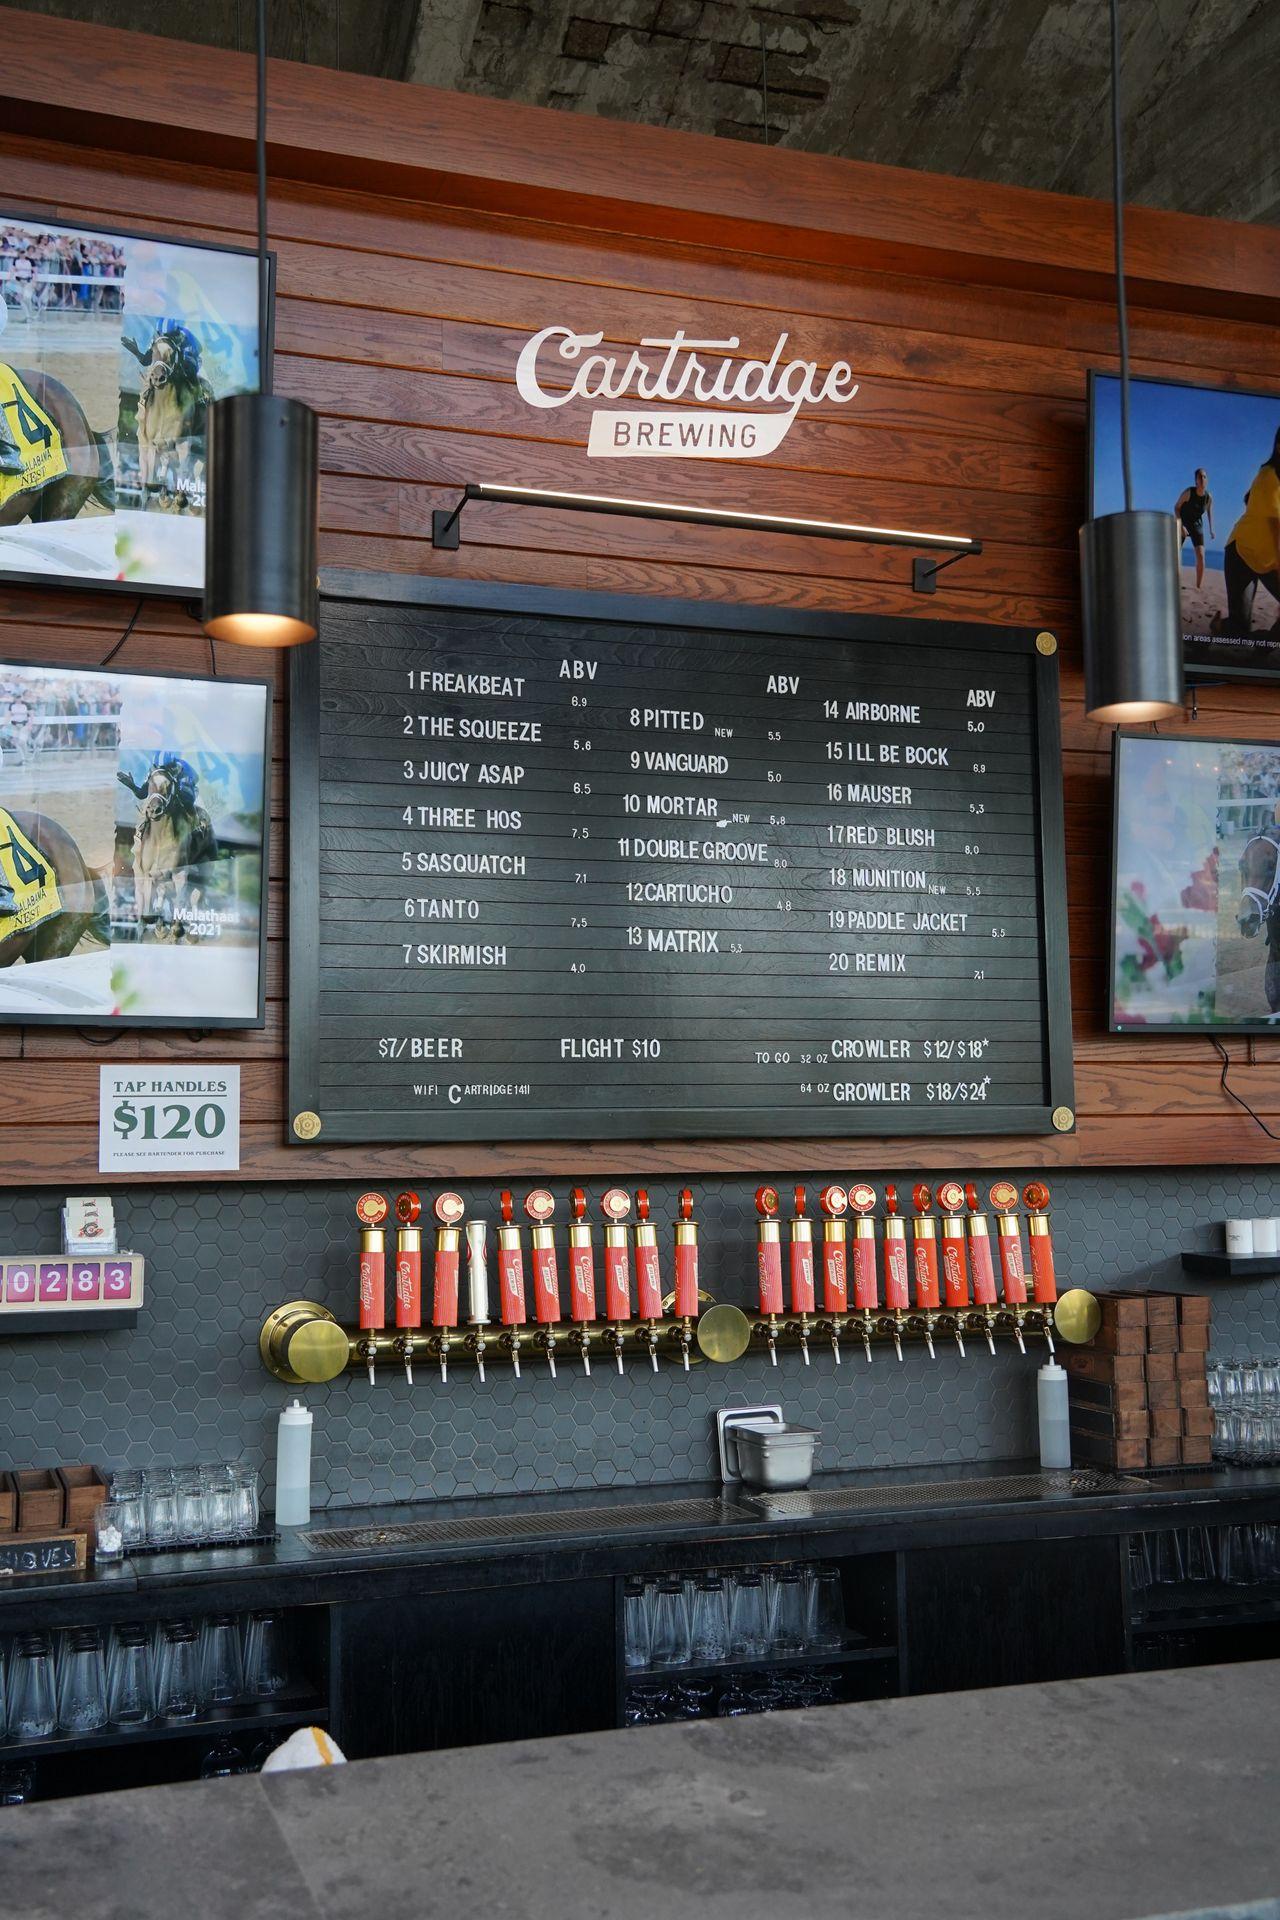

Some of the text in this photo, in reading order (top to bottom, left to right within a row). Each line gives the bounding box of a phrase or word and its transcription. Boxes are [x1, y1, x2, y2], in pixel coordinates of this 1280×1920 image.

[516, 326, 859, 410] Cartridge
[613, 421, 757, 448] BREWING
[559, 659, 598, 680] ABV
[420, 671, 525, 697] FREAKBEAT
[571, 695, 587, 707] 6.9
[766, 675, 800, 695] ABV
[966, 689, 996, 708] ABV
[630, 708, 781, 741] 8 PITTED NEW 5.5
[823, 700, 985, 733] 14 AIRBORNE 5.0
[403, 716, 591, 750] 2 THE SQUEEZE 5.6
[630, 751, 782, 783] 9 VANGUARD 5.0
[826, 742, 842, 760] 15
[879, 744, 900, 763] BE
[905, 746, 949, 766] BOCK
[403, 761, 591, 795] 3 JUICY ASAP 6.5
[623, 794, 786, 825] 10 MORTAR NEW 5.8
[827, 784, 984, 815] 16 MAUSER 5.3
[402, 806, 589, 839] 4 THREE HOS 7.5
[618, 838, 787, 868] 11 DOUBLE GROOVE 8.0
[887, 828, 935, 846] BLUSH
[965, 846, 979, 855] 8.0
[402, 853, 587, 884] 5 SASQUATCH 7.1
[829, 868, 981, 896] 18 MUNITION NEW 5.5
[404, 899, 587, 928] 6 TANTO 7.5
[776, 901, 792, 911] 4.8
[190, 923, 221, 936] 2021
[828, 911, 1006, 938] 19 PADDLE JACKET 5.5
[626, 926, 743, 953] 13 MATRIX 5.3
[402, 945, 586, 974] 7 SKIRMISH 4.0
[829, 953, 848, 971] 20
[856, 954, 906, 972] REMIX
[561, 1038, 660, 1059] FLIGHT $10
[755, 1052, 769, 1064] TO
[775, 1052, 790, 1063] GO
[800, 1054, 811, 1064] 32
[817, 1054, 828, 1064] OZ
[831, 1039, 911, 1058] CROWLER
[114, 1081, 227, 1093] TAP HANDLES
[413, 1085, 438, 1095] WIFI
[800, 1083, 812, 1093] 64
[817, 1083, 829, 1093] OZ
[833, 1082, 911, 1101] GROWLER
[113, 1100, 226, 1140] $120
